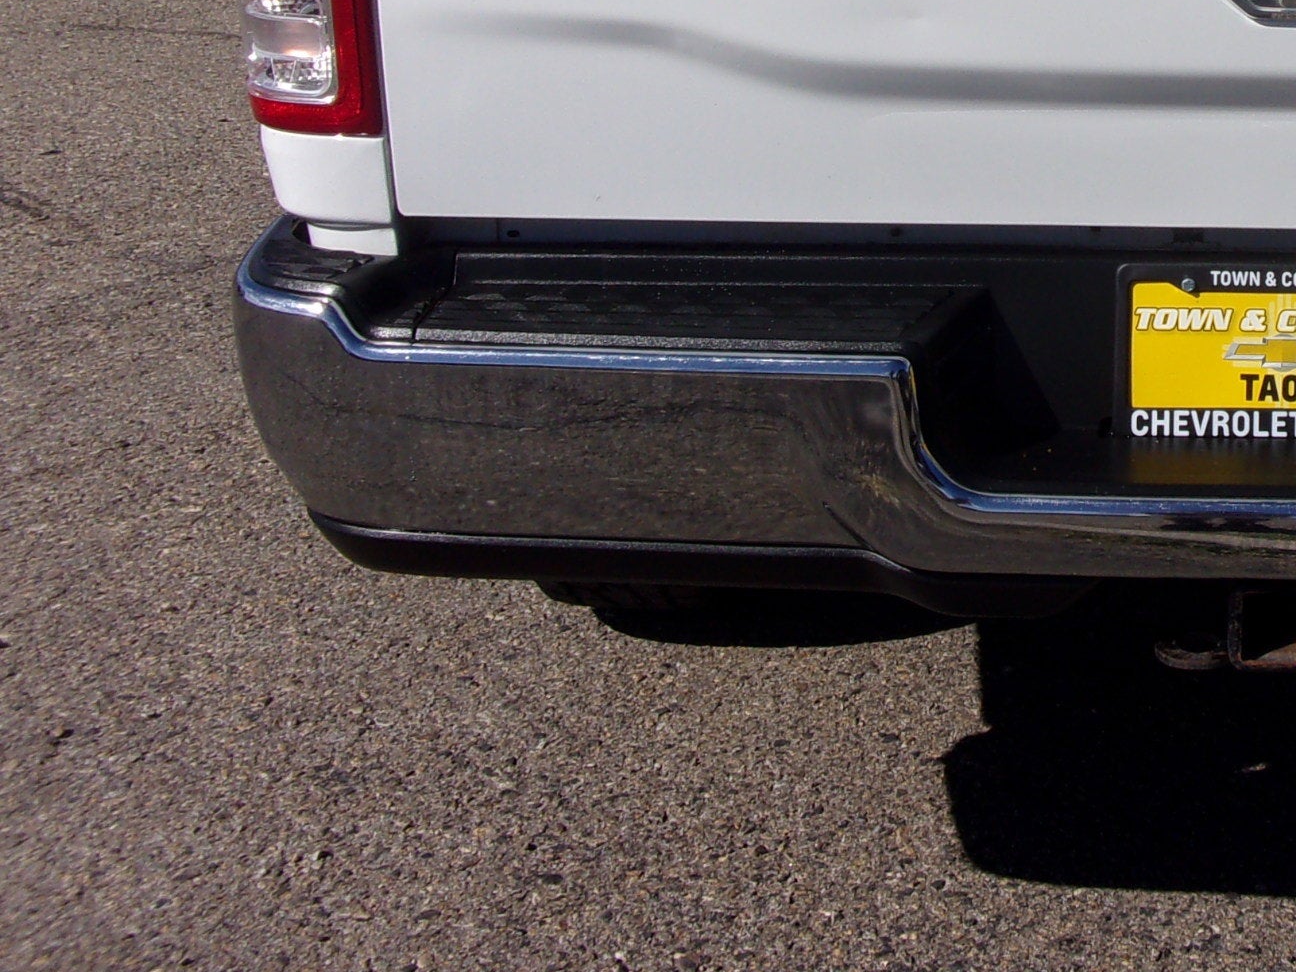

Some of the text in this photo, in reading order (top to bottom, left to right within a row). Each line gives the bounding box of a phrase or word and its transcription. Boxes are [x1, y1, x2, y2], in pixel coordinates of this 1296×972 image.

[1210, 270, 1261, 287] TOWN
[1265, 271, 1277, 287] &
[1134, 307, 1233, 331] TOWN
[1239, 308, 1267, 332] &
